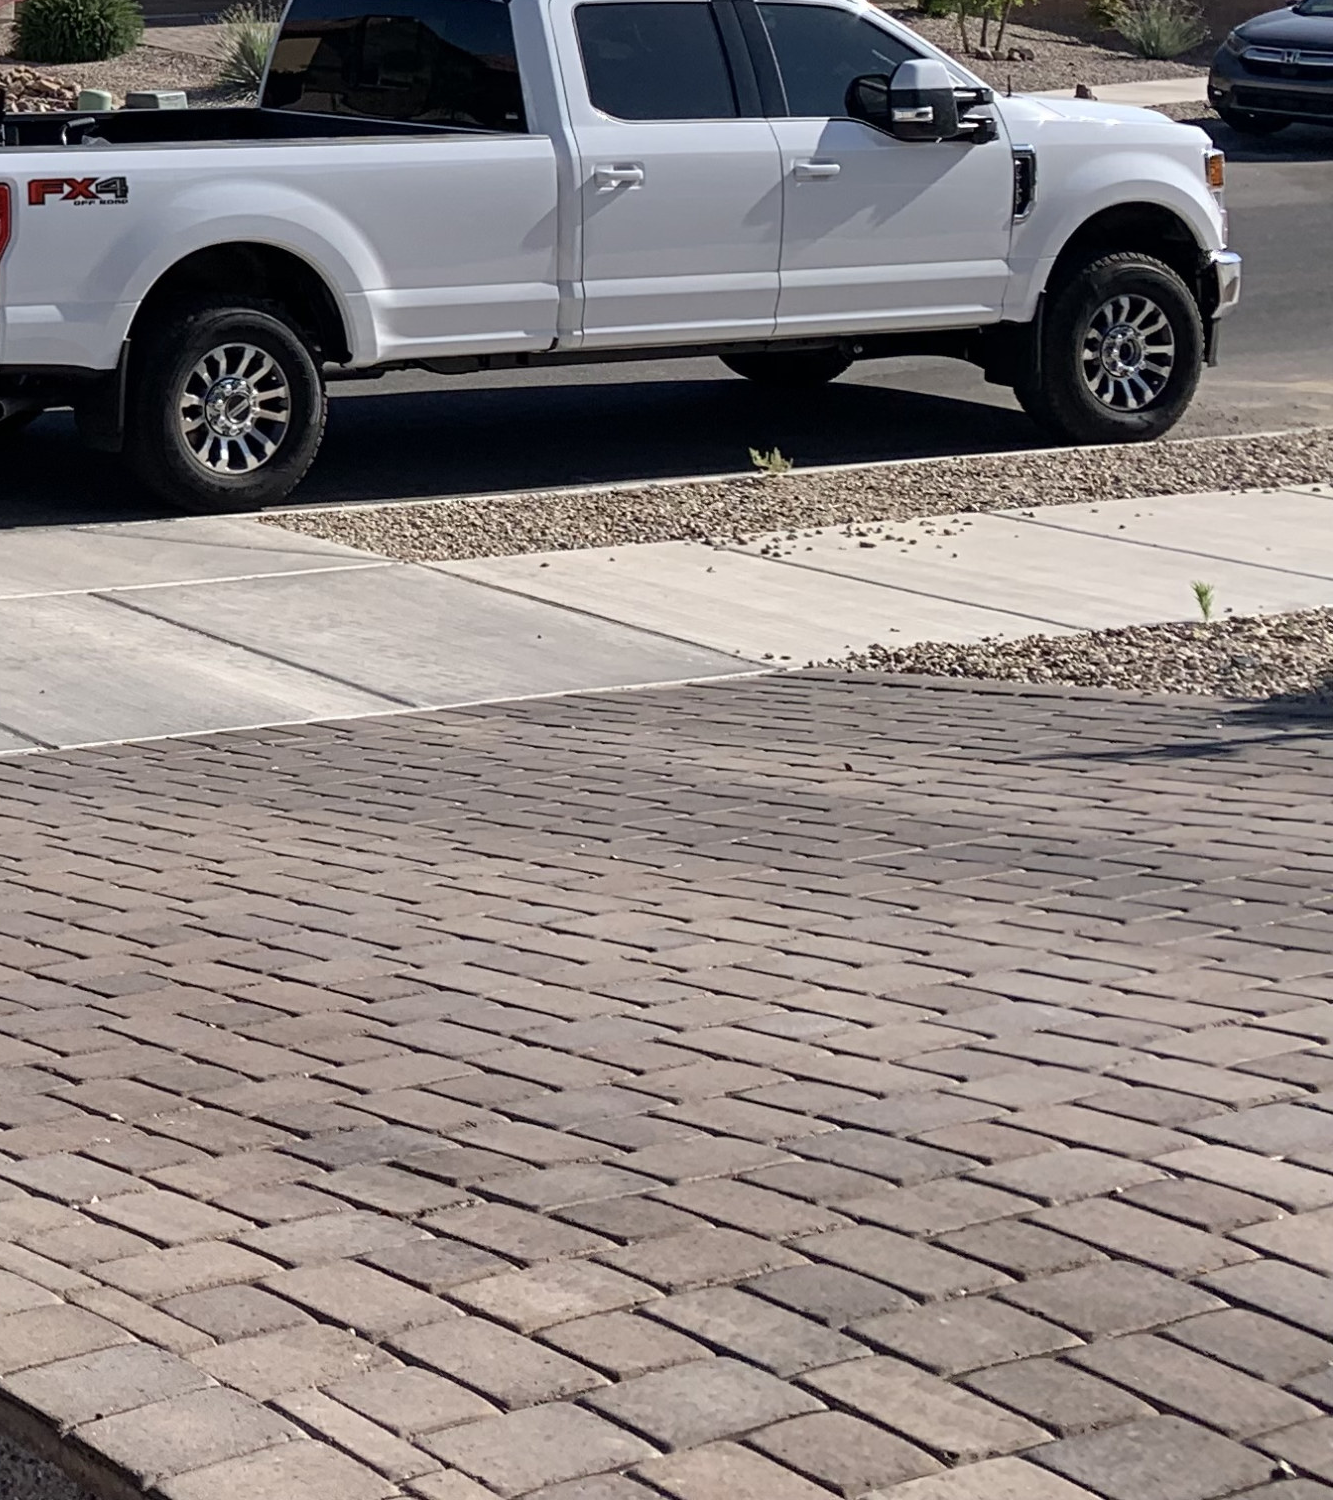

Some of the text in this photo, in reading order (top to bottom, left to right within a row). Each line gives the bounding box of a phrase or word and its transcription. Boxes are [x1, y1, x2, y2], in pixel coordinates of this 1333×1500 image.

[27, 176, 129, 206] FX4
[73, 198, 129, 207] OFF ROAD
